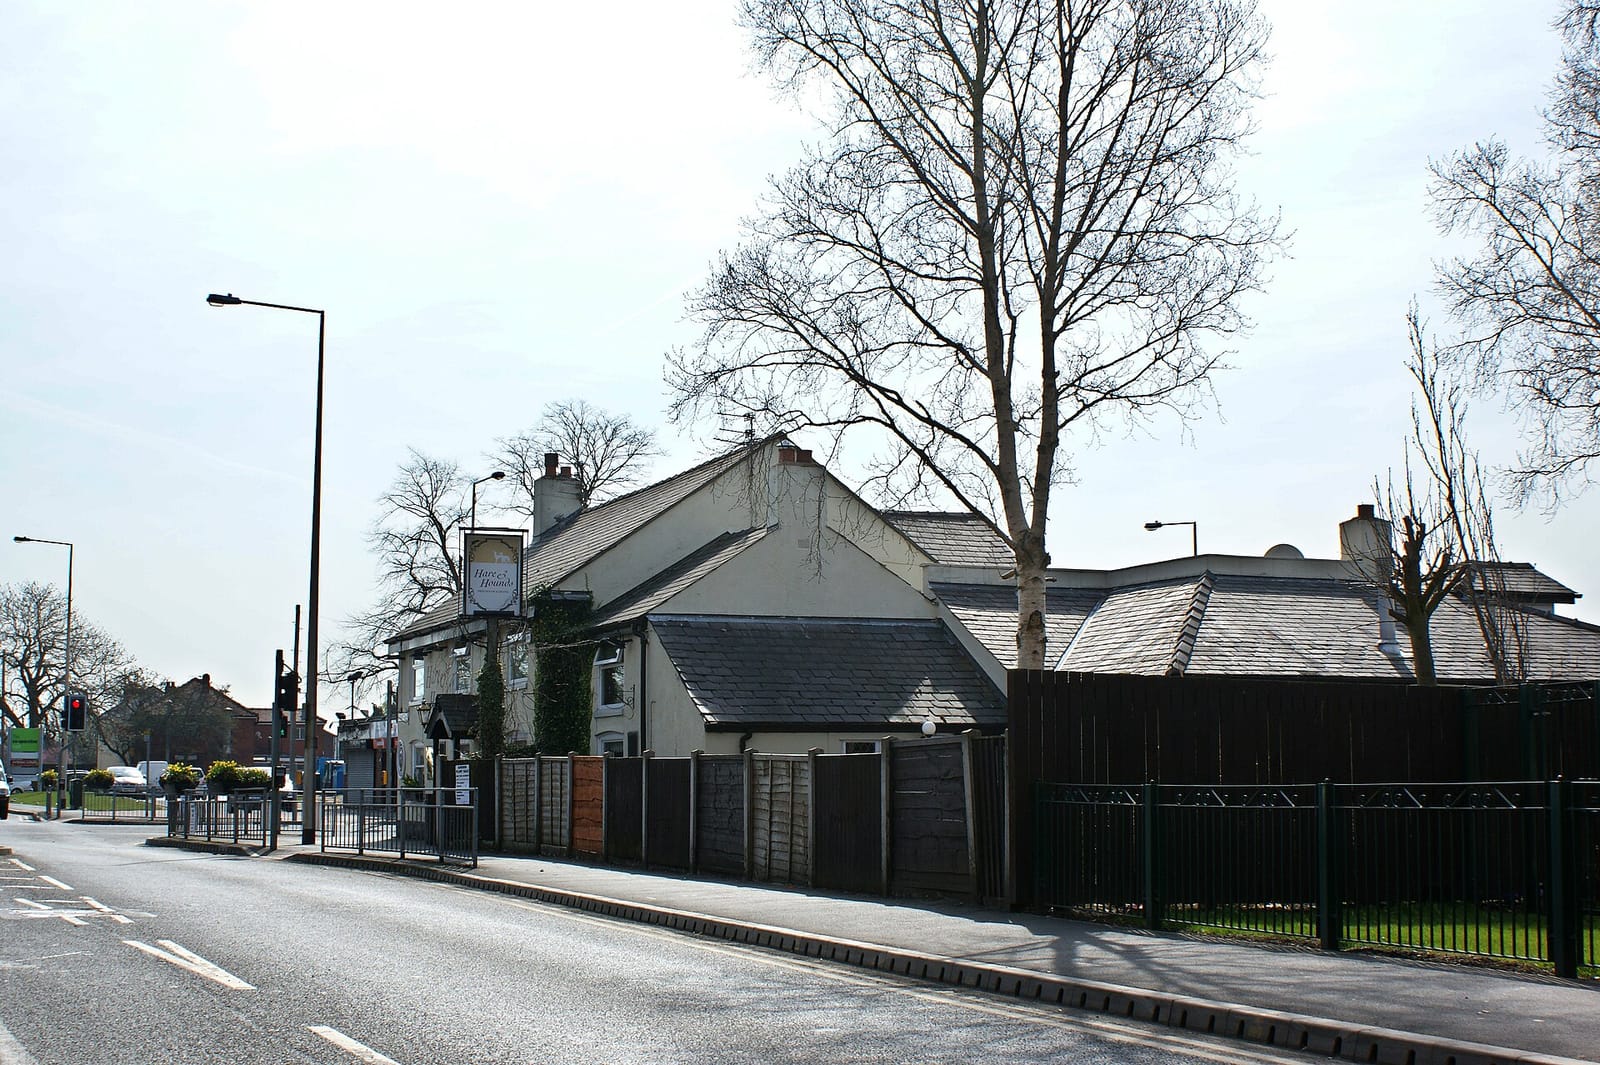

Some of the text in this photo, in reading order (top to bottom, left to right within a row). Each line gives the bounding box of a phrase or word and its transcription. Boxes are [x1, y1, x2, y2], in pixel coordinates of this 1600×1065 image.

[474, 568, 508, 579] Hare &
[480, 578, 514, 588] Hounds
